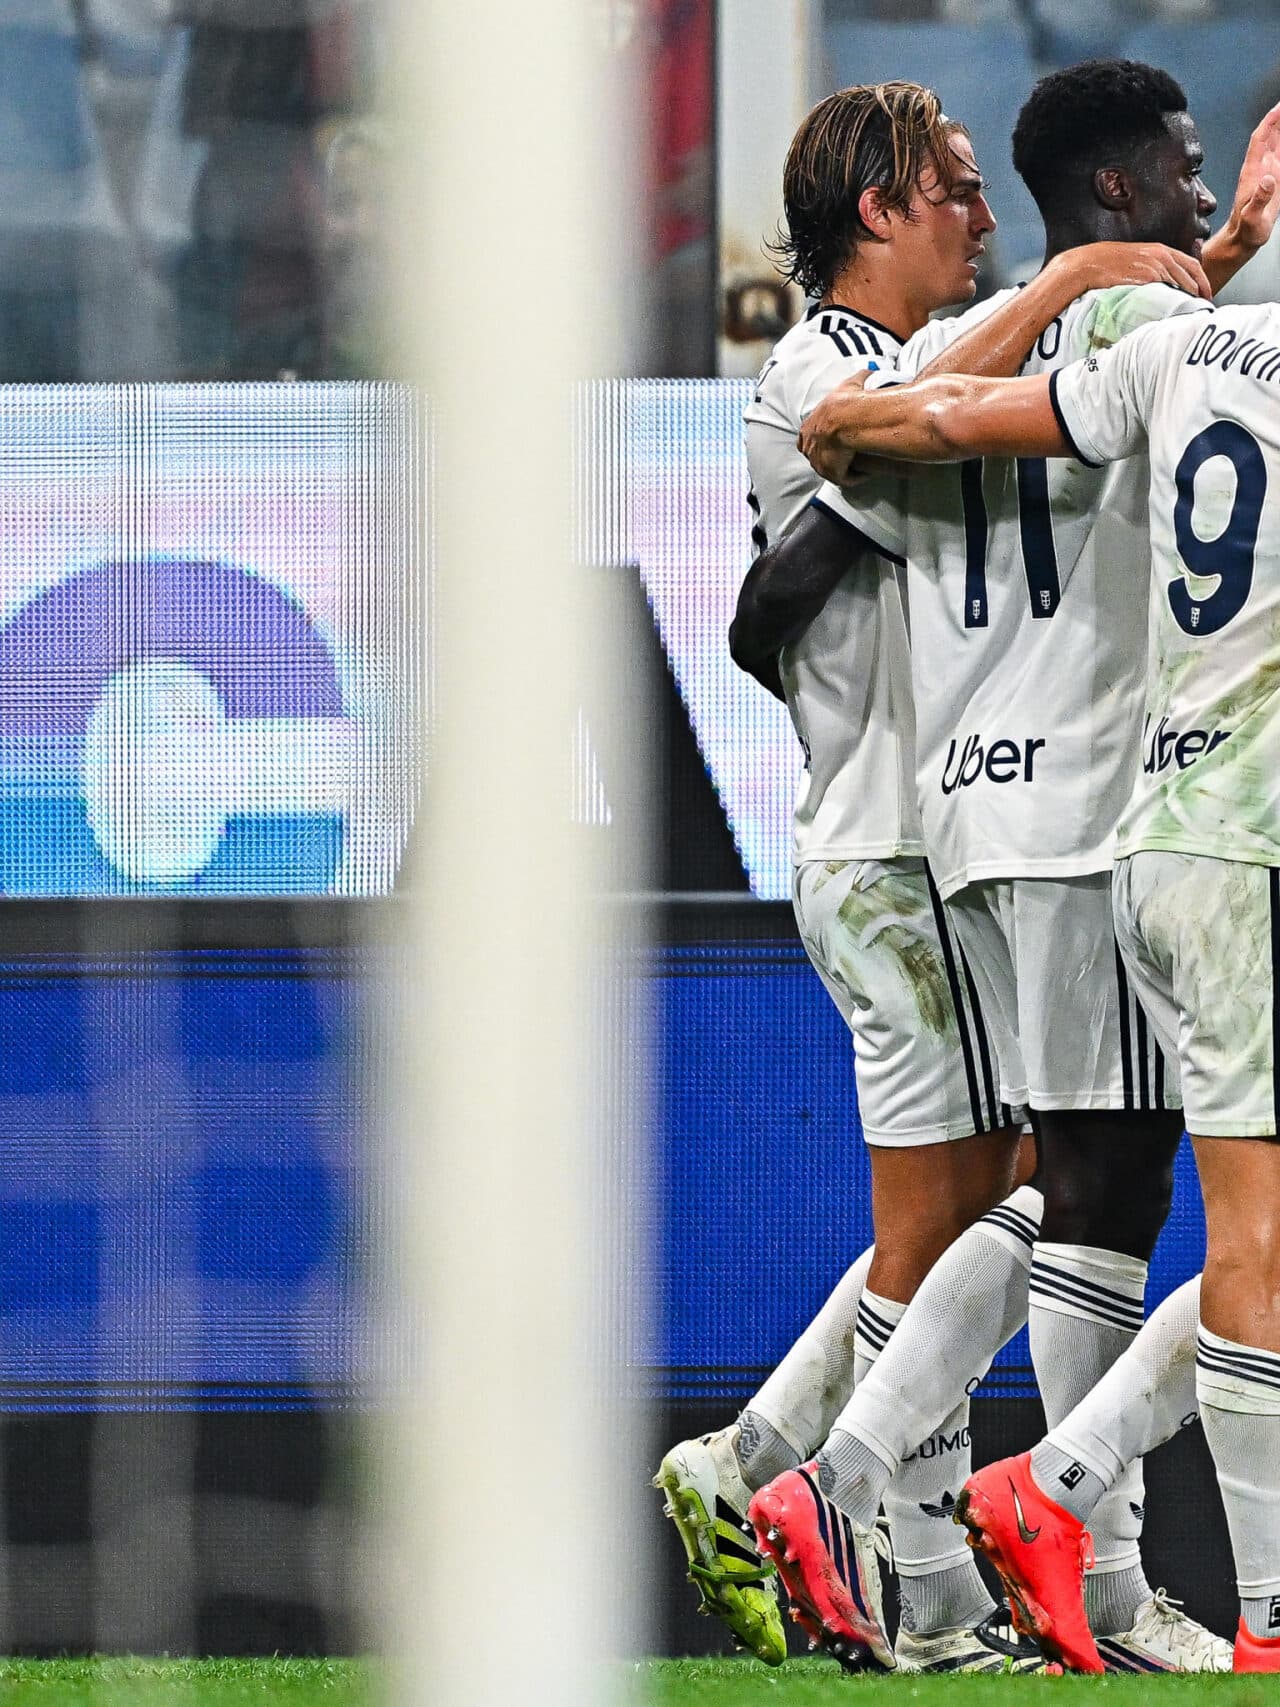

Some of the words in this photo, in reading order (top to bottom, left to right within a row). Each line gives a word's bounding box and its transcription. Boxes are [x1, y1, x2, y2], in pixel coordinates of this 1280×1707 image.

[961, 457, 1062, 628] 11
[1168, 419, 1268, 636] 9
[941, 734, 1045, 795] Uber
